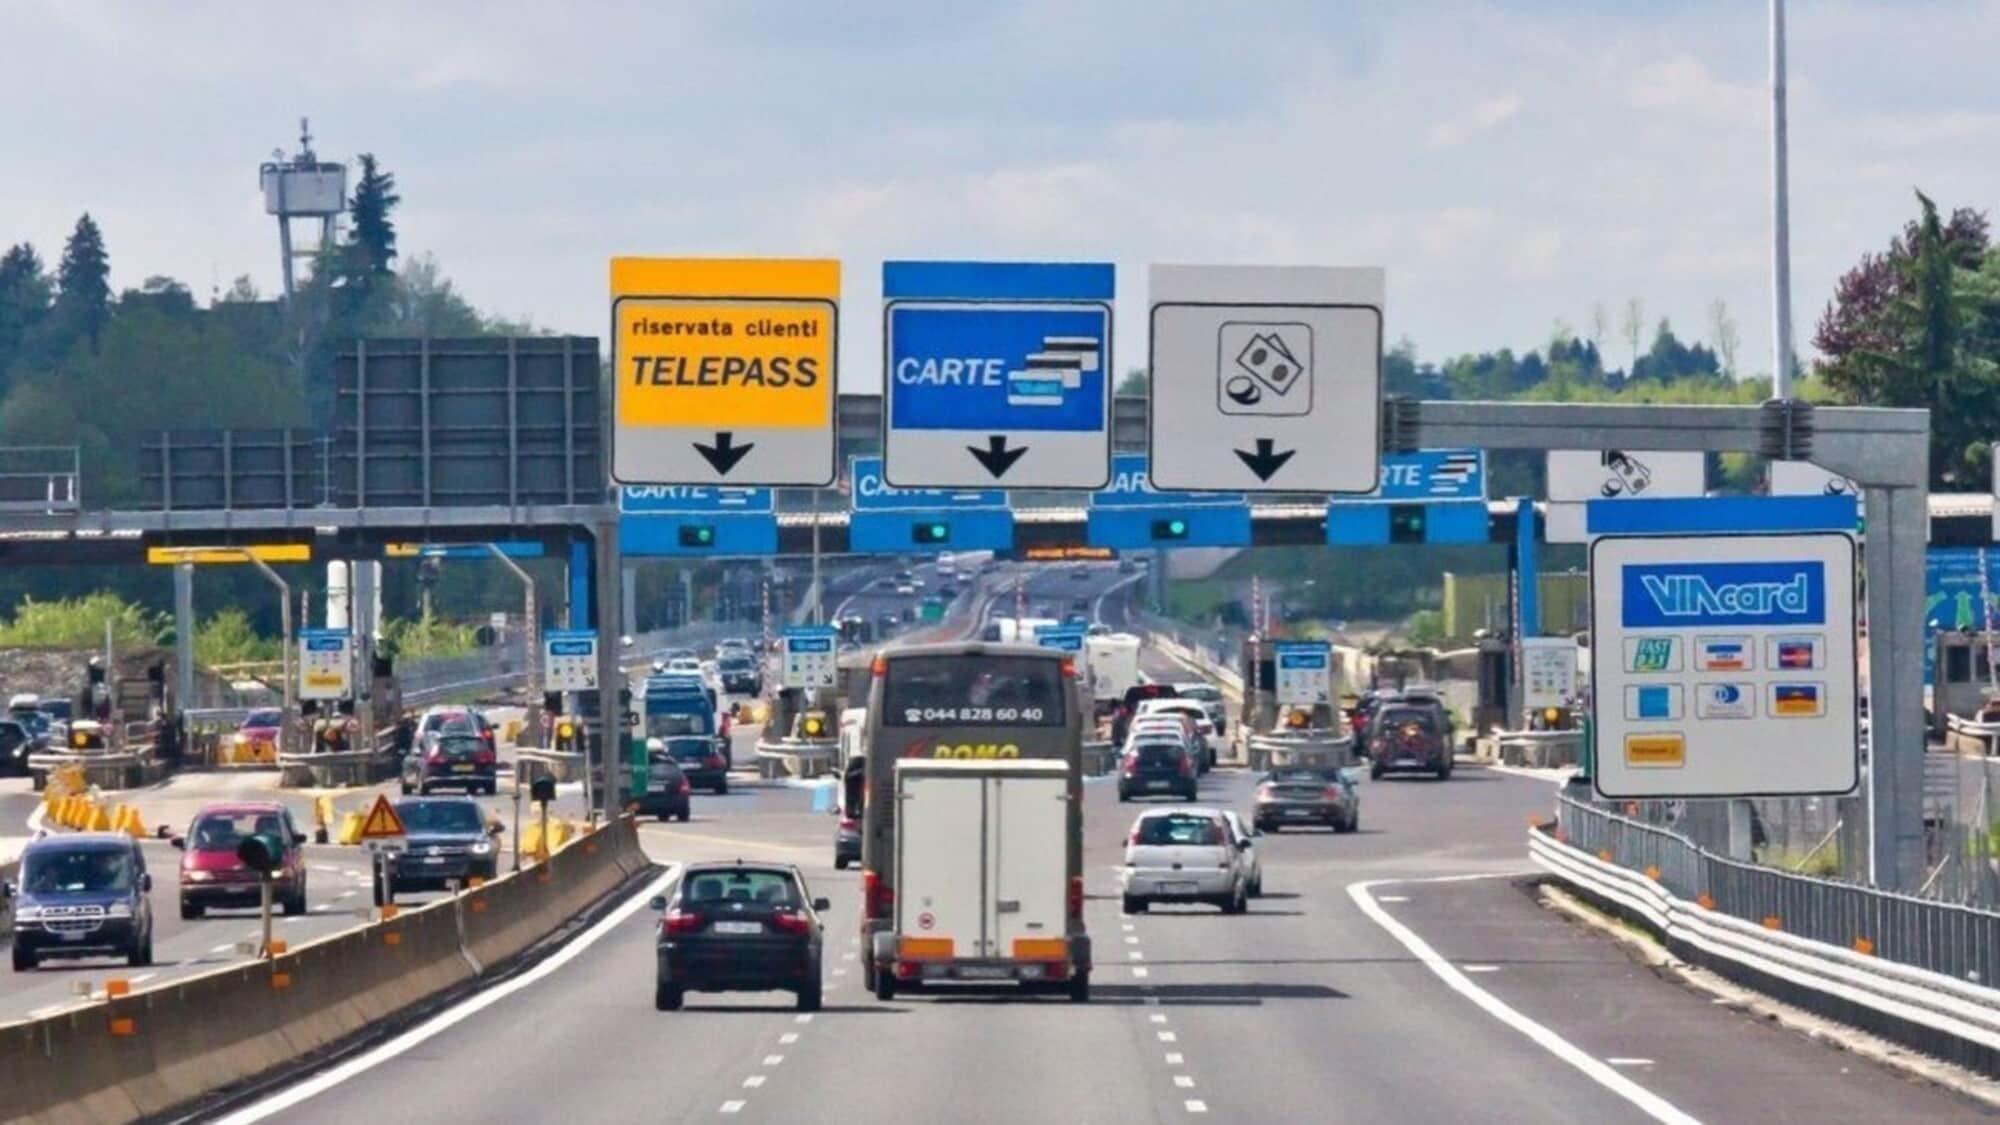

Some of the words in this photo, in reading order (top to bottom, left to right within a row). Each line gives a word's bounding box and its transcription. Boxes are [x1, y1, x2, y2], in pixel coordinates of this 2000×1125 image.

[632, 317, 733, 336] riservata
[745, 319, 819, 337] clienti
[631, 356, 819, 388] TELEPASS
[897, 357, 1005, 386] CARTE
[1380, 464, 1422, 486] RTE
[1640, 573, 1808, 616] VIAcard
[923, 708, 957, 721] 044
[959, 708, 993, 721] 828
[996, 708, 1018, 721] 60
[1020, 708, 1044, 721] 40
